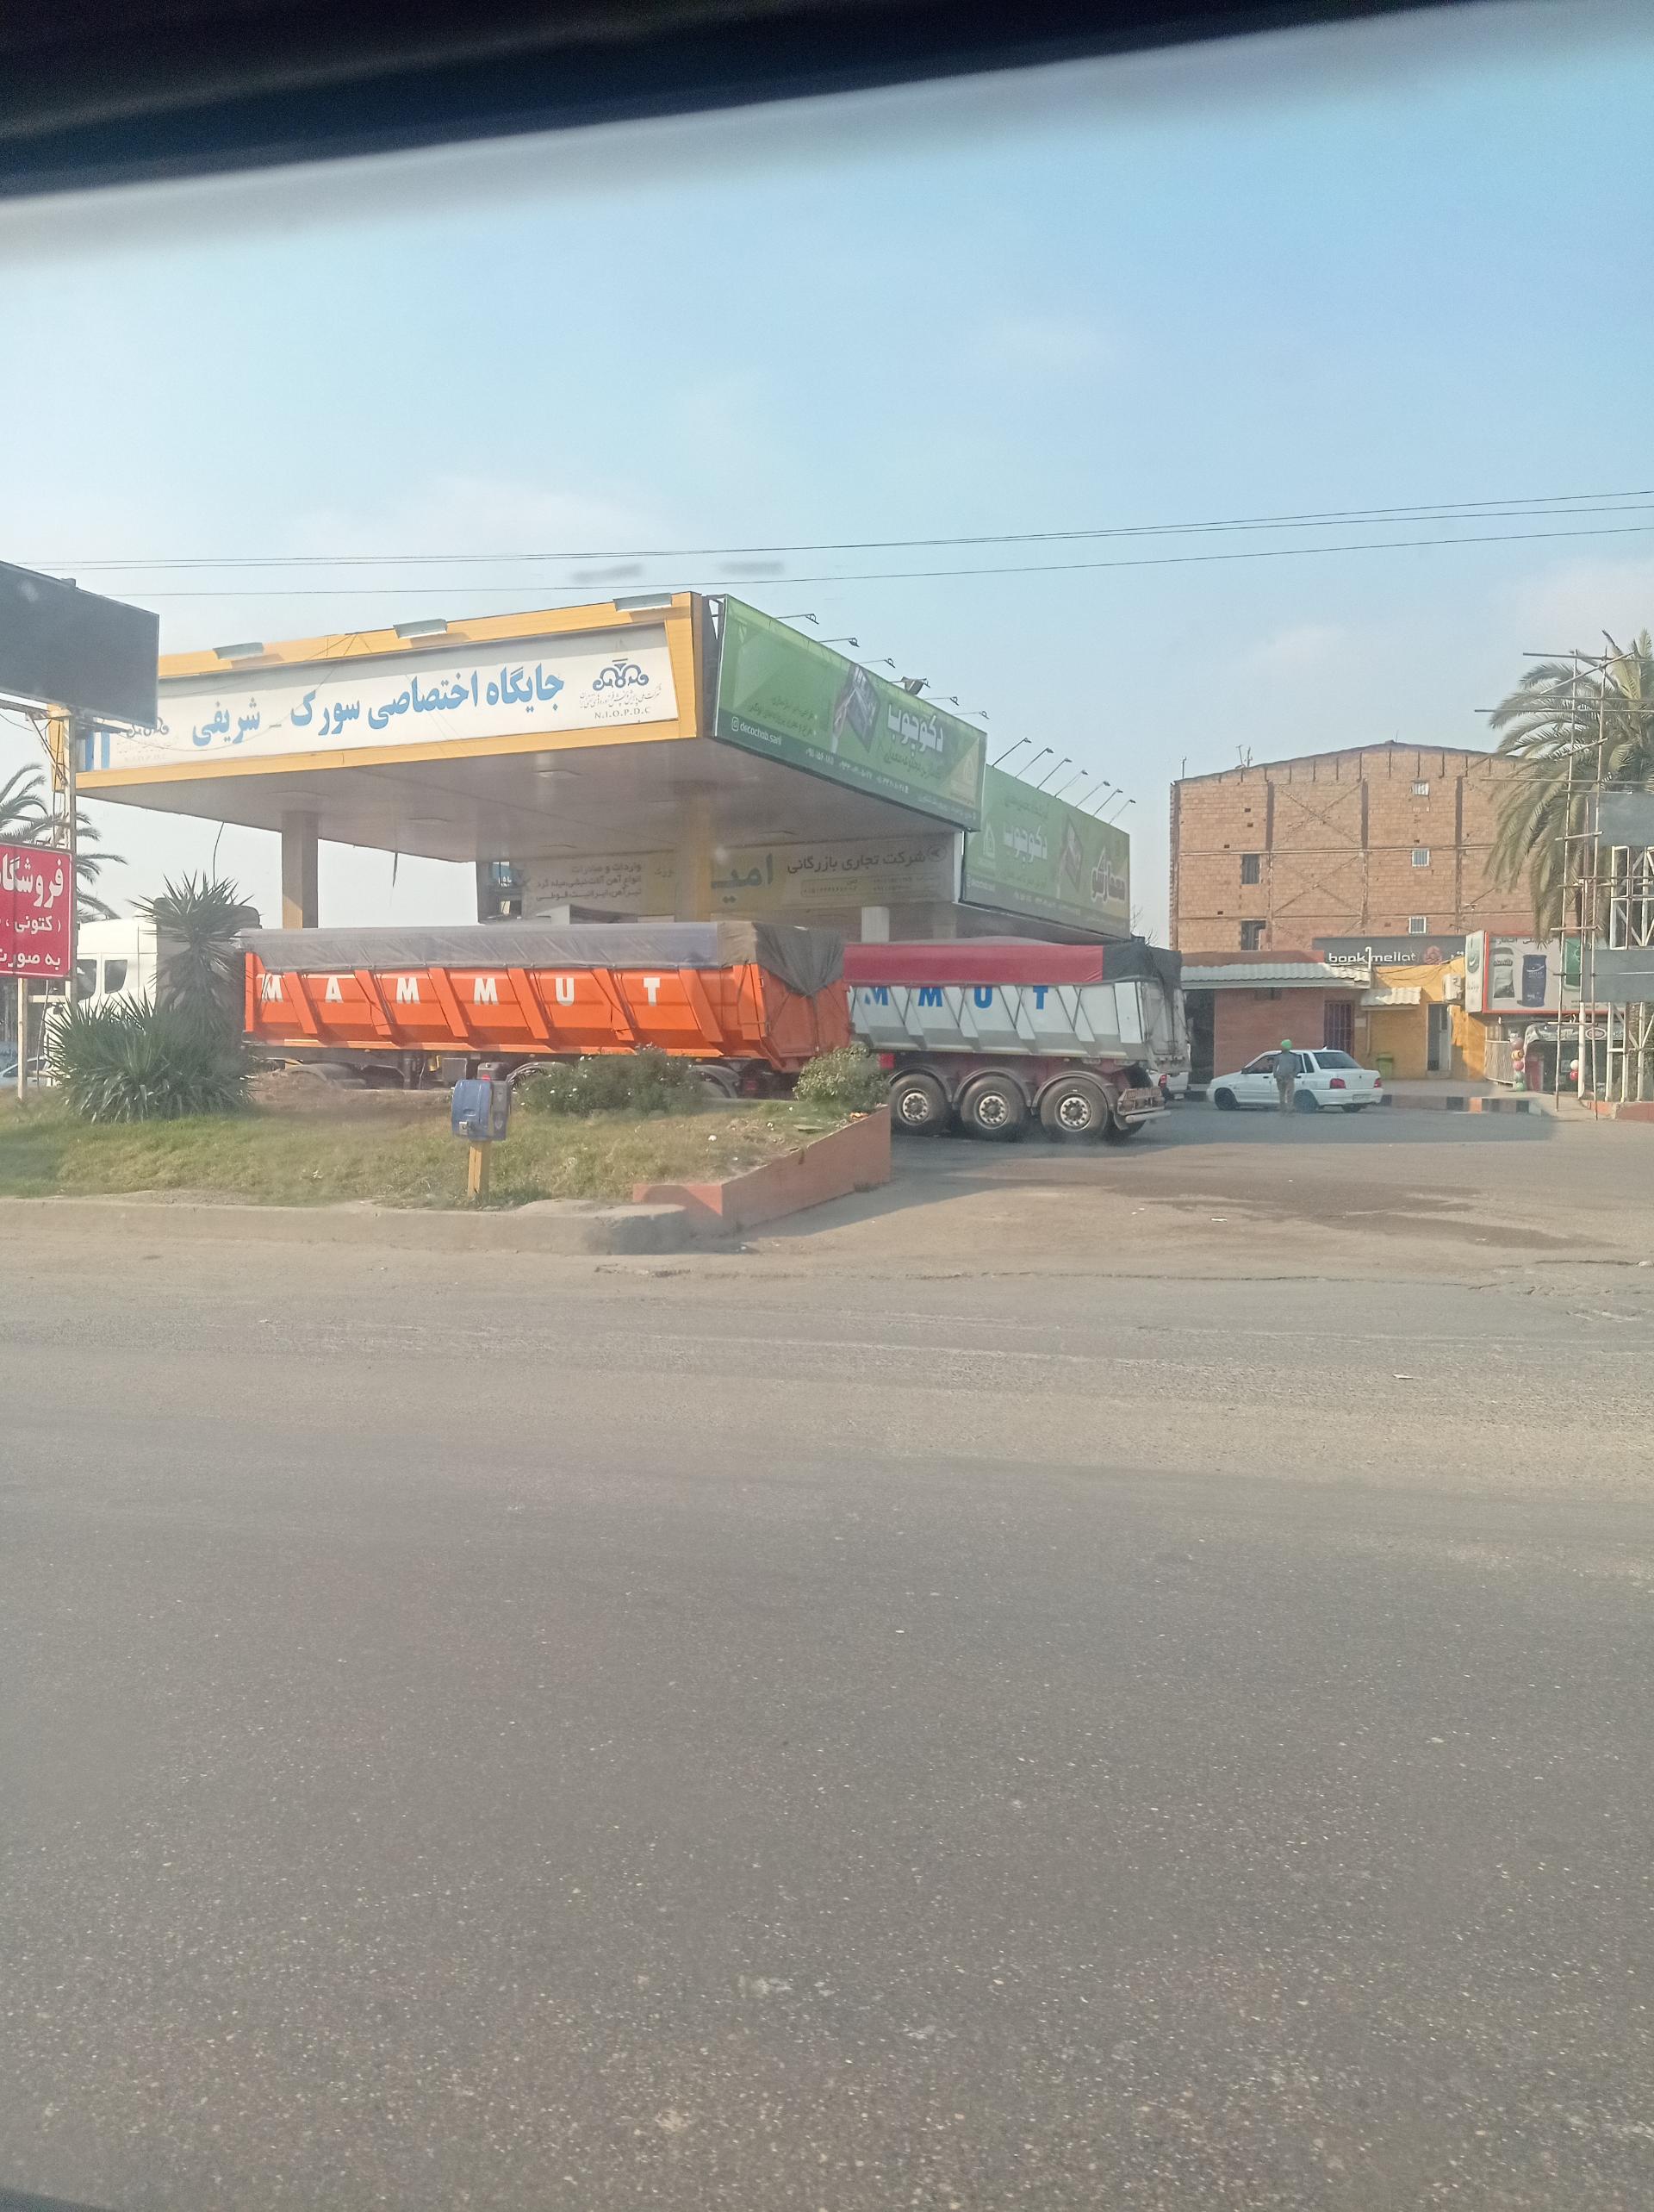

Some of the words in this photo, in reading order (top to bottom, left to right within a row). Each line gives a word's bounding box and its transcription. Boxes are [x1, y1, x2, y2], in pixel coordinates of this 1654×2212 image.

[367, 669, 479, 731] اختصاصی
[487, 663, 565, 713] جایگاه
[192, 697, 261, 747] شریفی
[289, 691, 360, 738] سورک
[787, 854, 838, 874] بازرگانی
[842, 854, 880, 871] تجاری
[883, 850, 926, 867] شرکت
[0, 852, 64, 908] فروشگا
[14, 914, 53, 935] کتونی
[44, 952, 61, 970] به
[1371, 950, 1416, 963] mellat
[260, 975, 661, 1006] MAMMUT
[864, 985, 1049, 1010] MMUT
